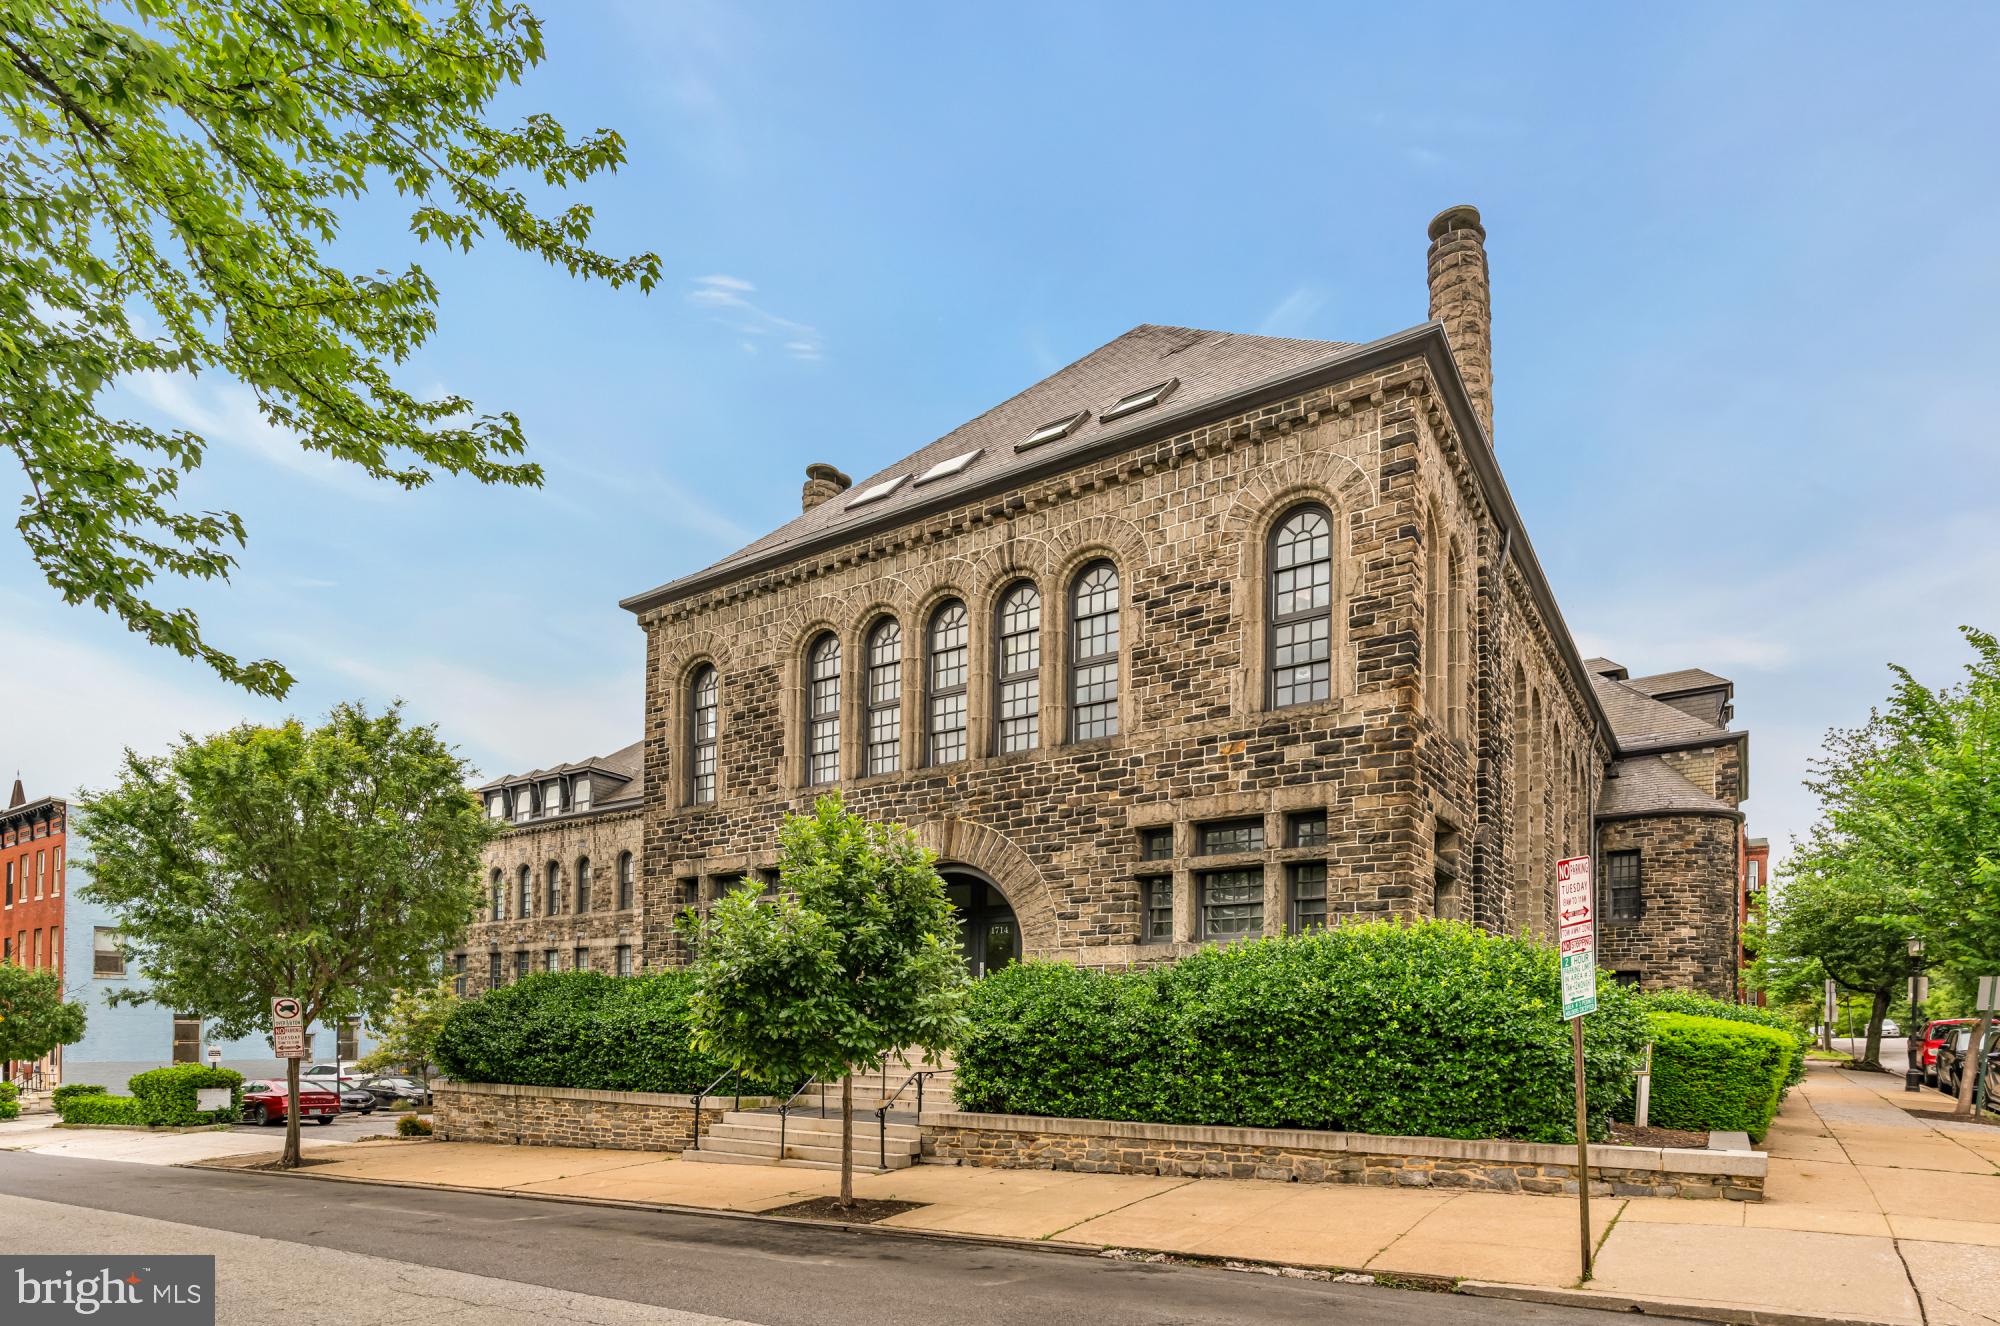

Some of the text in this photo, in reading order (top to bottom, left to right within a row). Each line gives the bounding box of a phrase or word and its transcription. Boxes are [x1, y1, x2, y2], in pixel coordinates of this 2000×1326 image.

[1559, 862, 1588, 880] NO PARKING
[1561, 881, 1588, 895] TUESDAY
[991, 926, 1009, 935] 1714
[1564, 954, 1589, 966] 2 HOUR
[275, 1027, 285, 1035] NO
